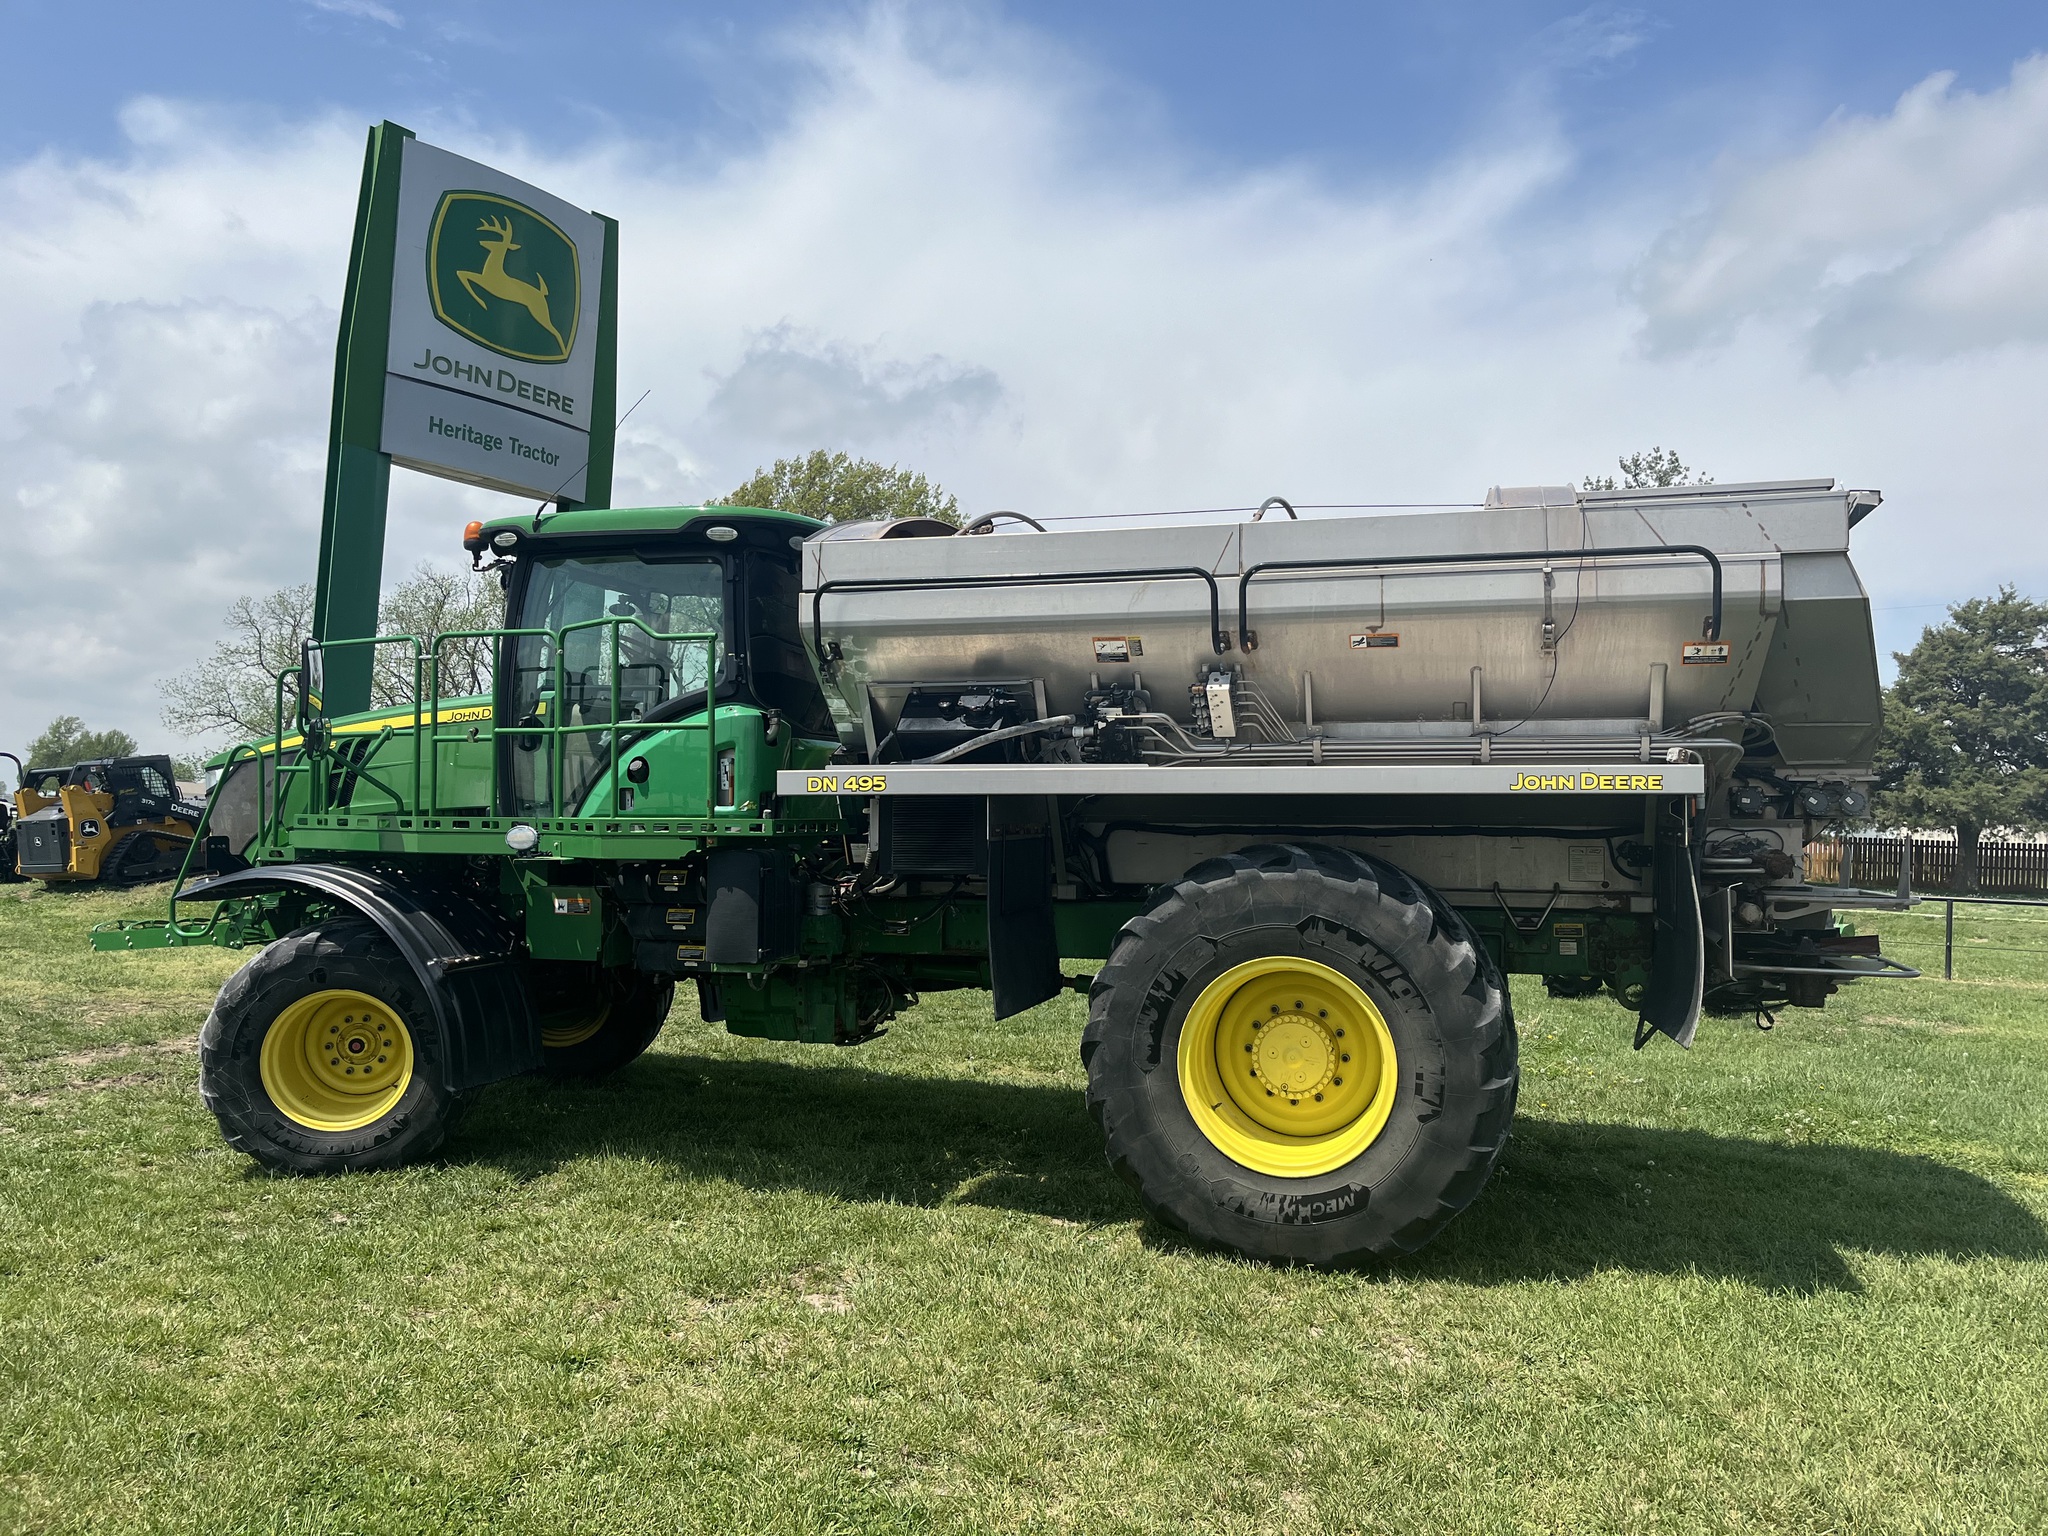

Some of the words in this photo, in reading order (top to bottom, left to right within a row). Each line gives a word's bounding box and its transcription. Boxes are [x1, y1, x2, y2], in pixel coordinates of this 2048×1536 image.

[413, 348, 492, 388] JOHN
[497, 369, 574, 415] DEERE
[428, 415, 503, 451] Heritage
[509, 436, 560, 467] Tractor
[447, 710, 480, 722] JOHN
[806, 776, 837, 792] DN
[843, 775, 887, 792] 495
[1509, 772, 1575, 791] JOHN
[1580, 771, 1663, 791] DEERE
[170, 803, 200, 818] DEERE
